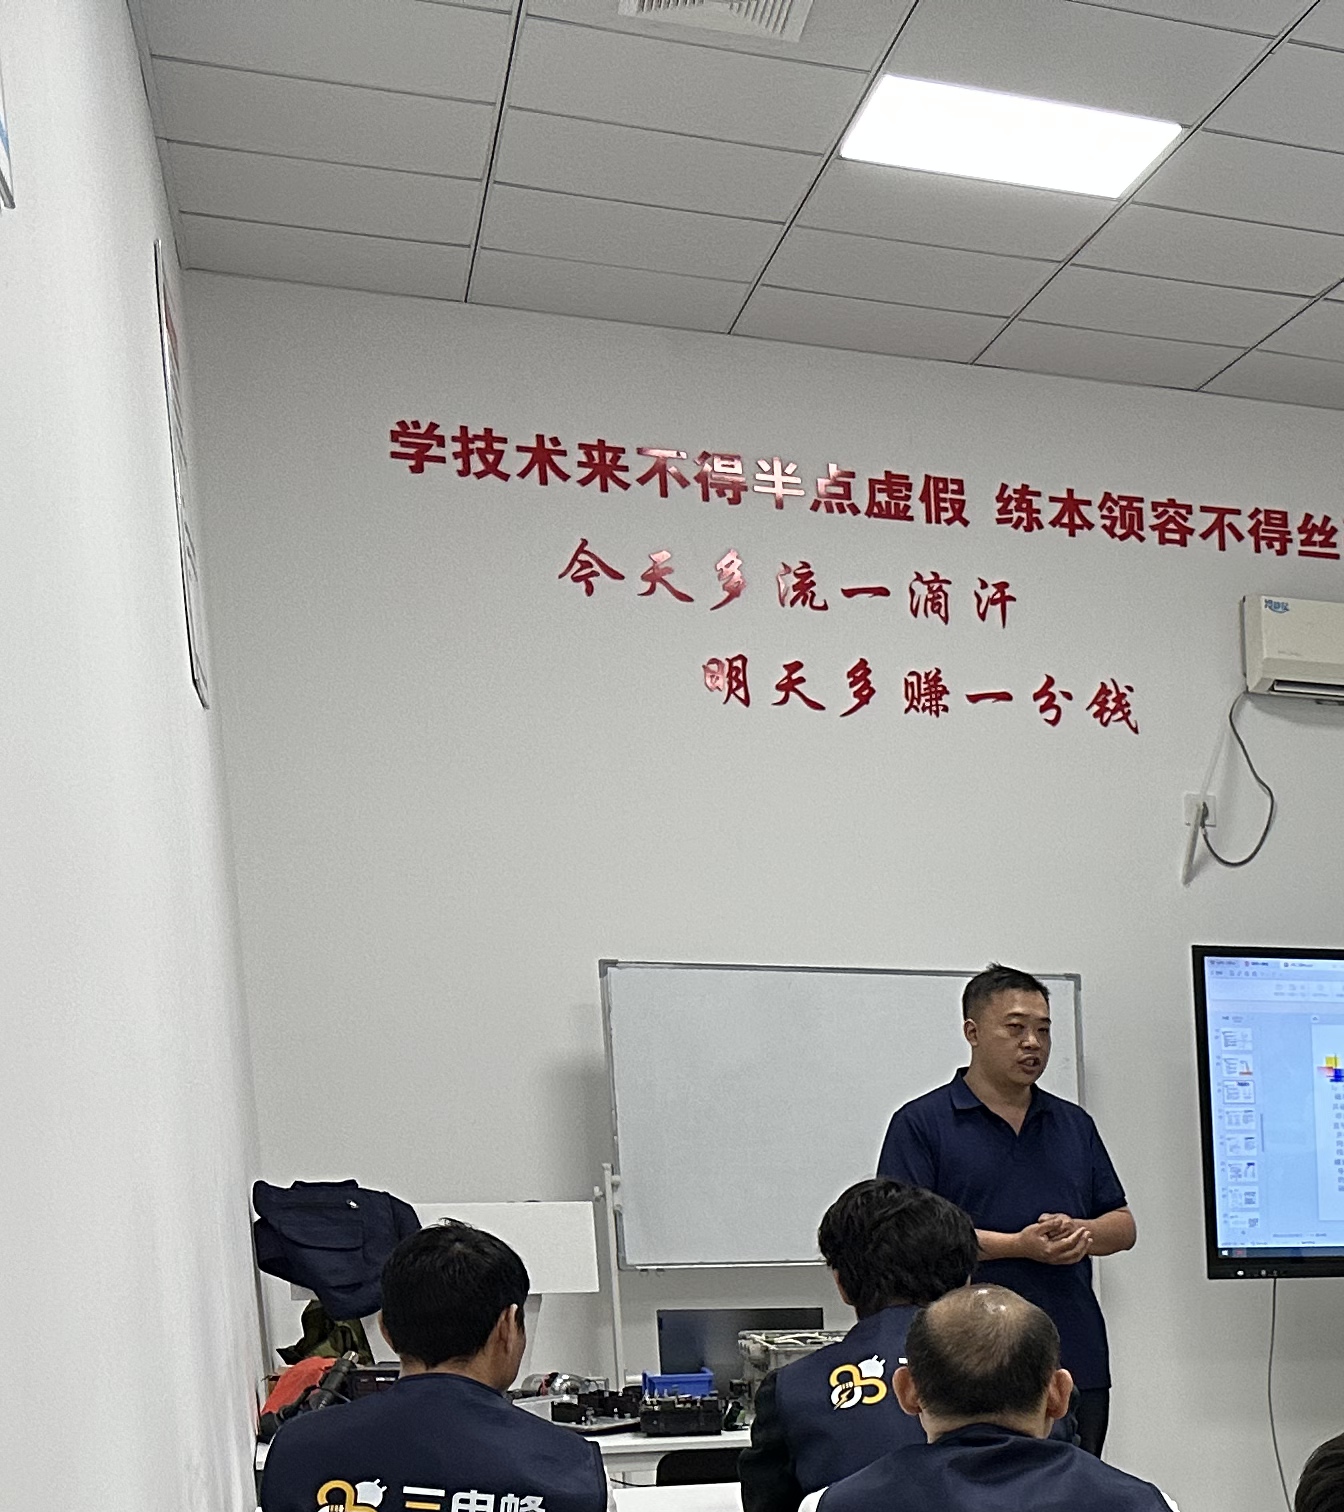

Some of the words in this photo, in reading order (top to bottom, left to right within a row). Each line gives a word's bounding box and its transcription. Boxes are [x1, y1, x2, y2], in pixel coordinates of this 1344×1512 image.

[389, 419, 969, 528] 学技术来不得半点虚假
[558, 537, 1016, 630] 今天多流一滴汗
[703, 654, 1142, 736] 明天多赚一分钱
